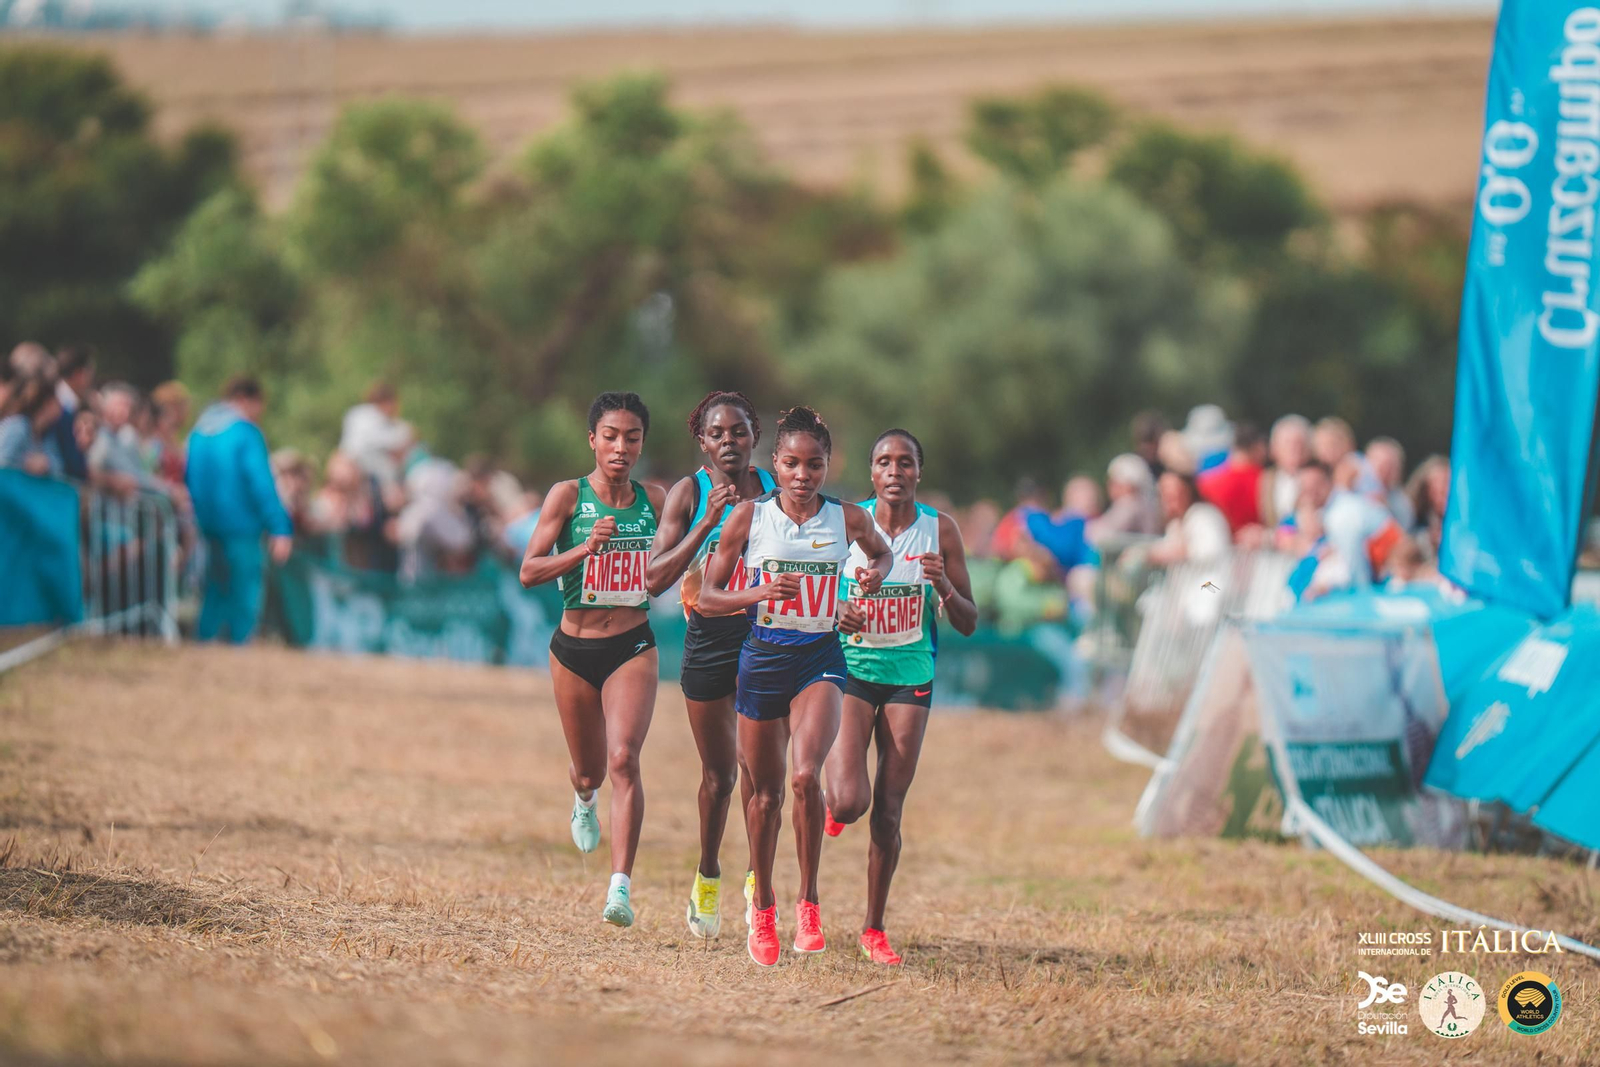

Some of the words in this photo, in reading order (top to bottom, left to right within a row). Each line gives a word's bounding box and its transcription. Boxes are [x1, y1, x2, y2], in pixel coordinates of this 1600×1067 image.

[617, 523, 642, 533] csa
[607, 540, 641, 550] ITÁLICA
[783, 562, 820, 573] ITÁLICA
[853, 596, 922, 634] EPKEMEI
